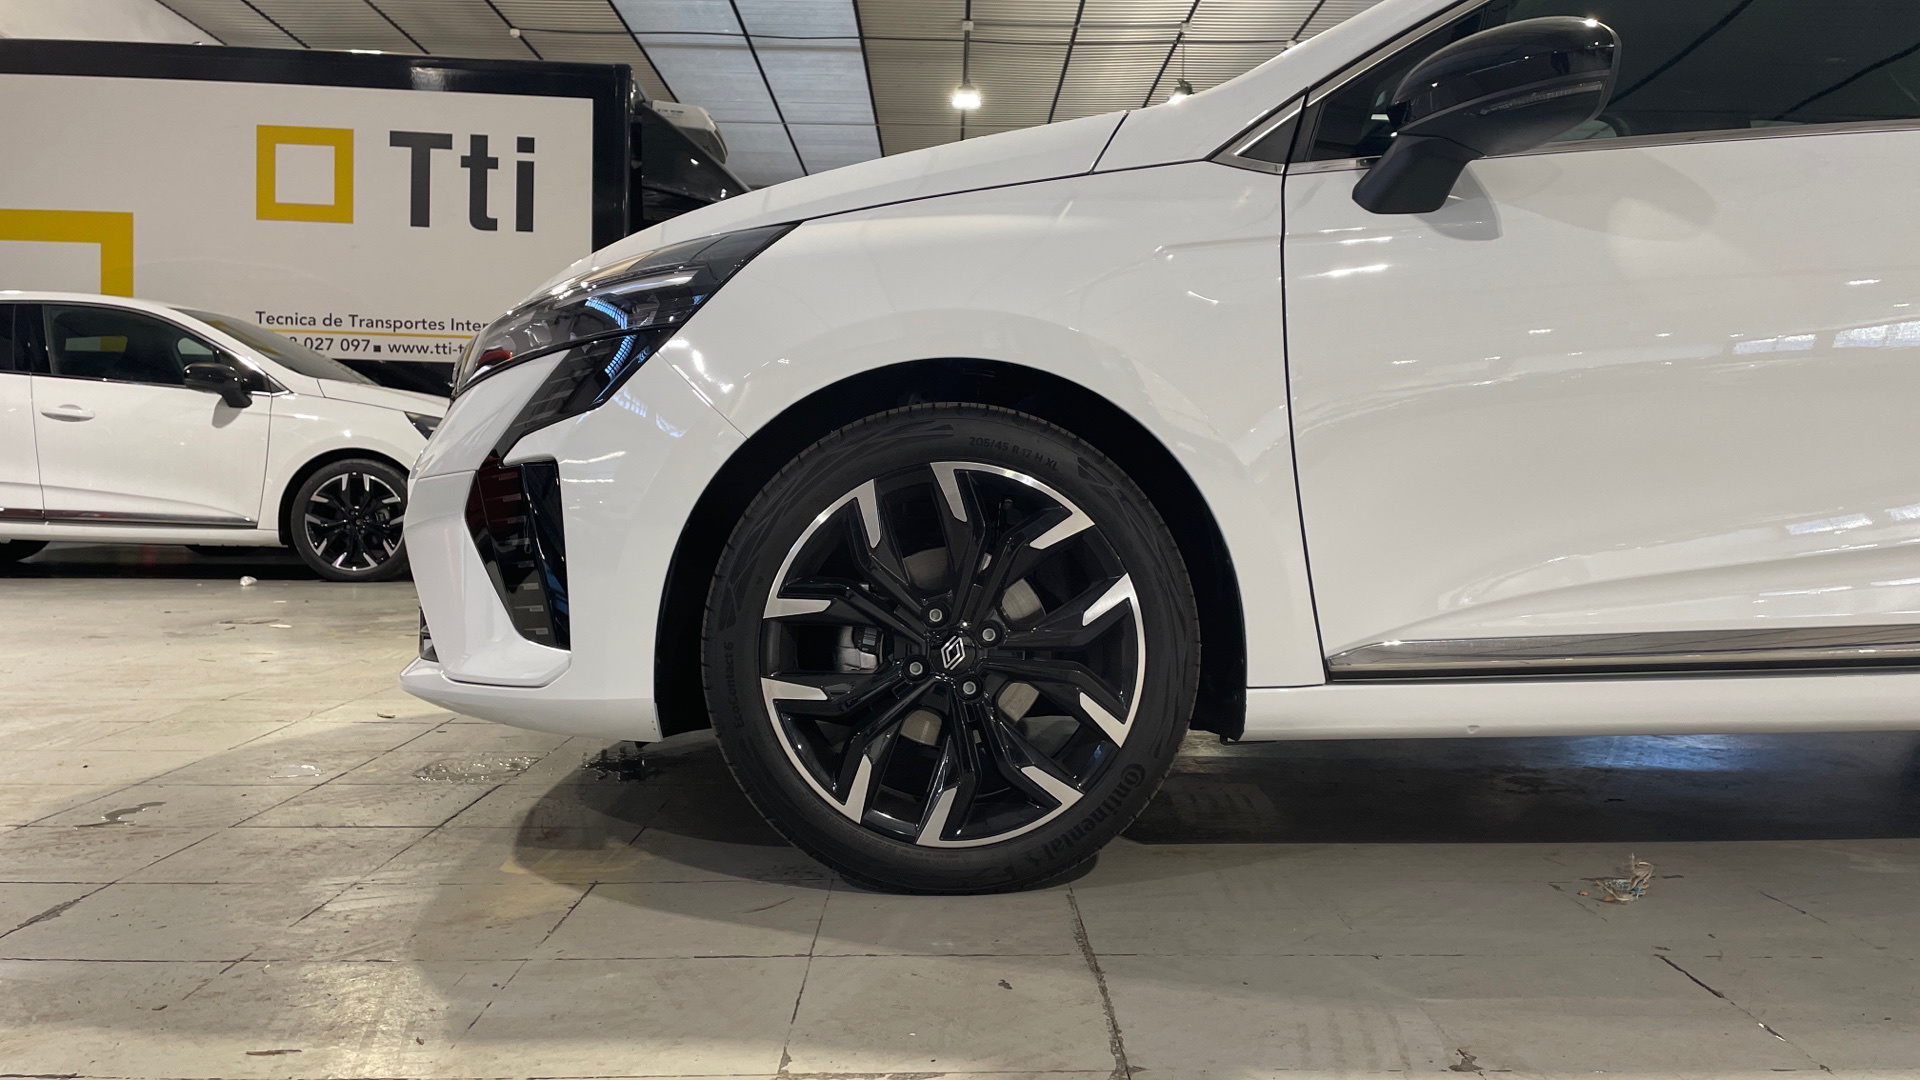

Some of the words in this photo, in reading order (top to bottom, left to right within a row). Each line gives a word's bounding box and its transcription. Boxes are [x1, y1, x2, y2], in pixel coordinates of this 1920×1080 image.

[389, 130, 535, 232] Tti
[255, 311, 316, 326] Tecnica
[322, 312, 343, 327] de
[348, 314, 445, 333] Transportes
[303, 336, 334, 351] 027
[340, 338, 370, 352] 097
[968, 436, 1009, 451] 205/45
[1011, 444, 1020, 455] R
[724, 652, 745, 729] EcoContact
[1041, 763, 1146, 860] Continental
